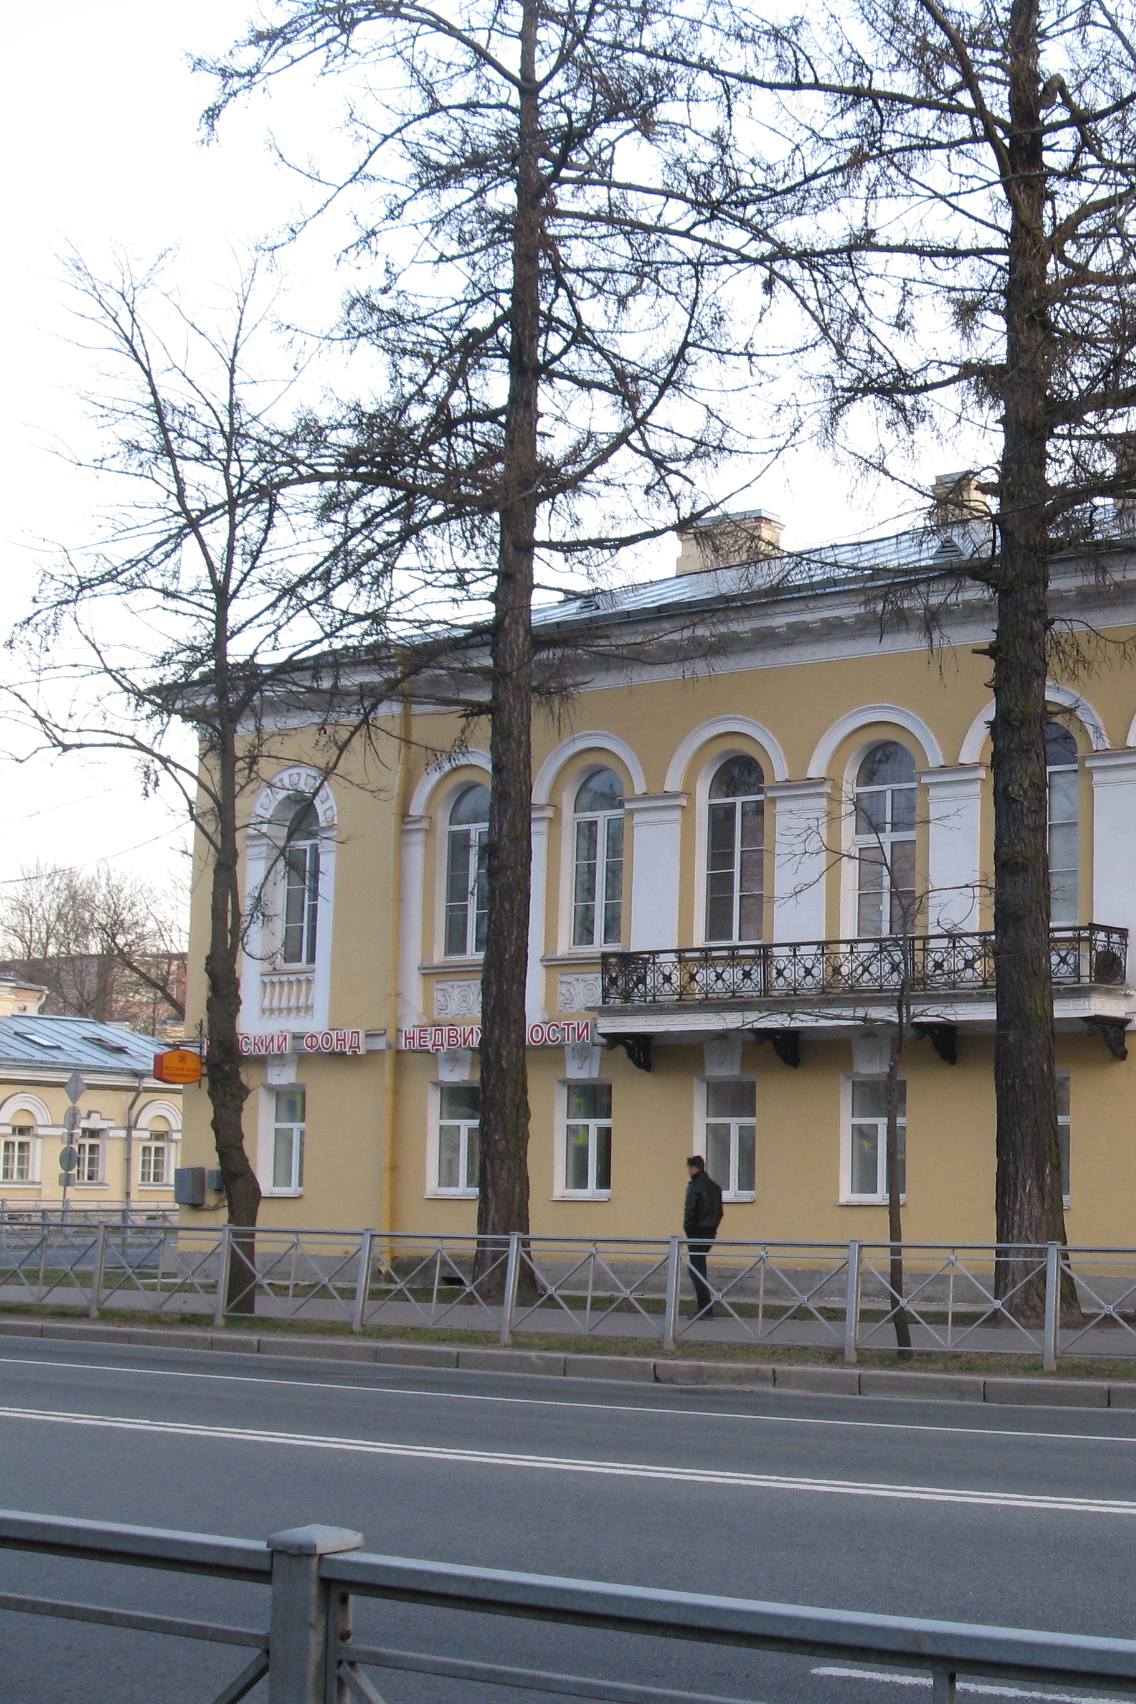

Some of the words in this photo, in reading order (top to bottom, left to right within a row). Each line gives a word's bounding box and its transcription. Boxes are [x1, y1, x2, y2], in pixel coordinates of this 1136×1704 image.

[205, 1029, 289, 1055] СКИЙ
[303, 1029, 362, 1054] ФОНД
[403, 1020, 590, 1053] НЕДВИОСТИ
